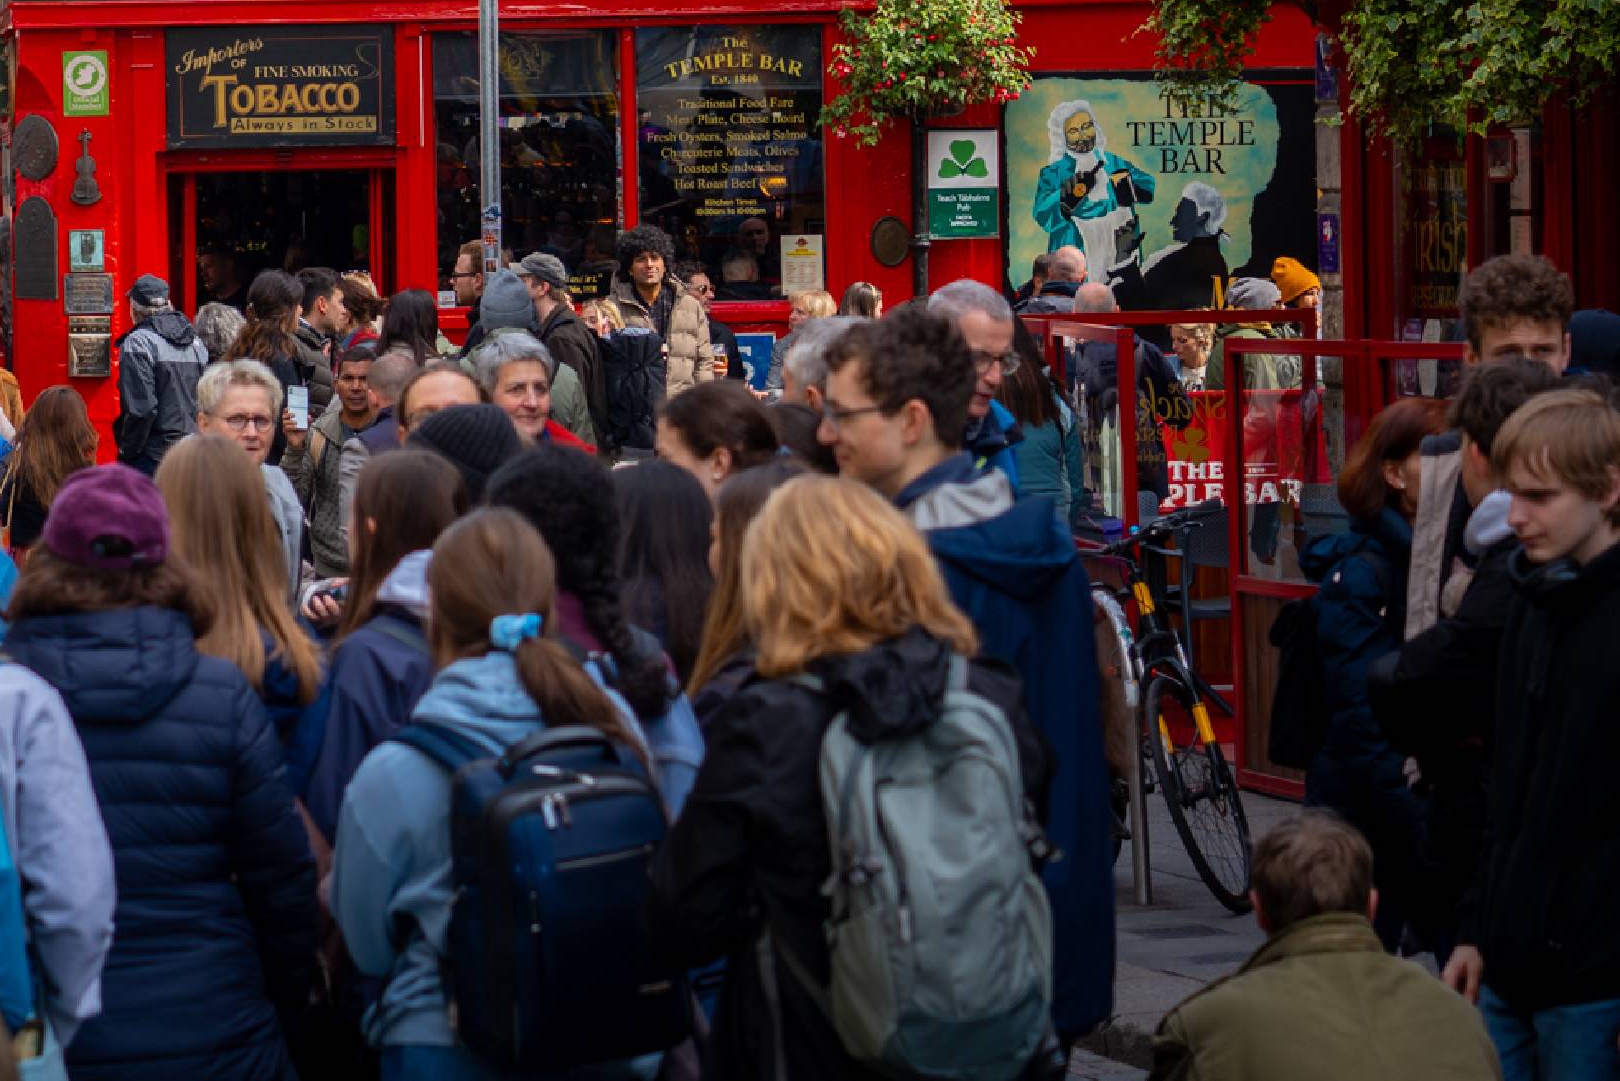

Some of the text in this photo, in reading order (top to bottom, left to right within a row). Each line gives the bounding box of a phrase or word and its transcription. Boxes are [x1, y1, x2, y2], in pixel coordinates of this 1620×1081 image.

[723, 37, 749, 48] The
[175, 37, 265, 74] Importers
[230, 58, 248, 68] OF
[664, 52, 804, 78] TEMPLE BAR
[253, 64, 360, 78] FINE SMOKING
[198, 73, 361, 129] TOBACCO
[740, 97, 767, 108] Food
[771, 97, 794, 108] Fare
[233, 115, 373, 132] Always in Stock
[731, 113, 770, 124] Cheese
[647, 132, 677, 142] Fresh
[727, 129, 771, 142] Smoked
[1126, 121, 1256, 147] TEMPLE
[764, 145, 800, 157] Olives
[1159, 147, 1227, 174] BAR
[677, 162, 784, 174] Toasted Sandwiches
[698, 178, 729, 189] Roast
[731, 177, 757, 188] Beef
[1168, 460, 1224, 481] THE
